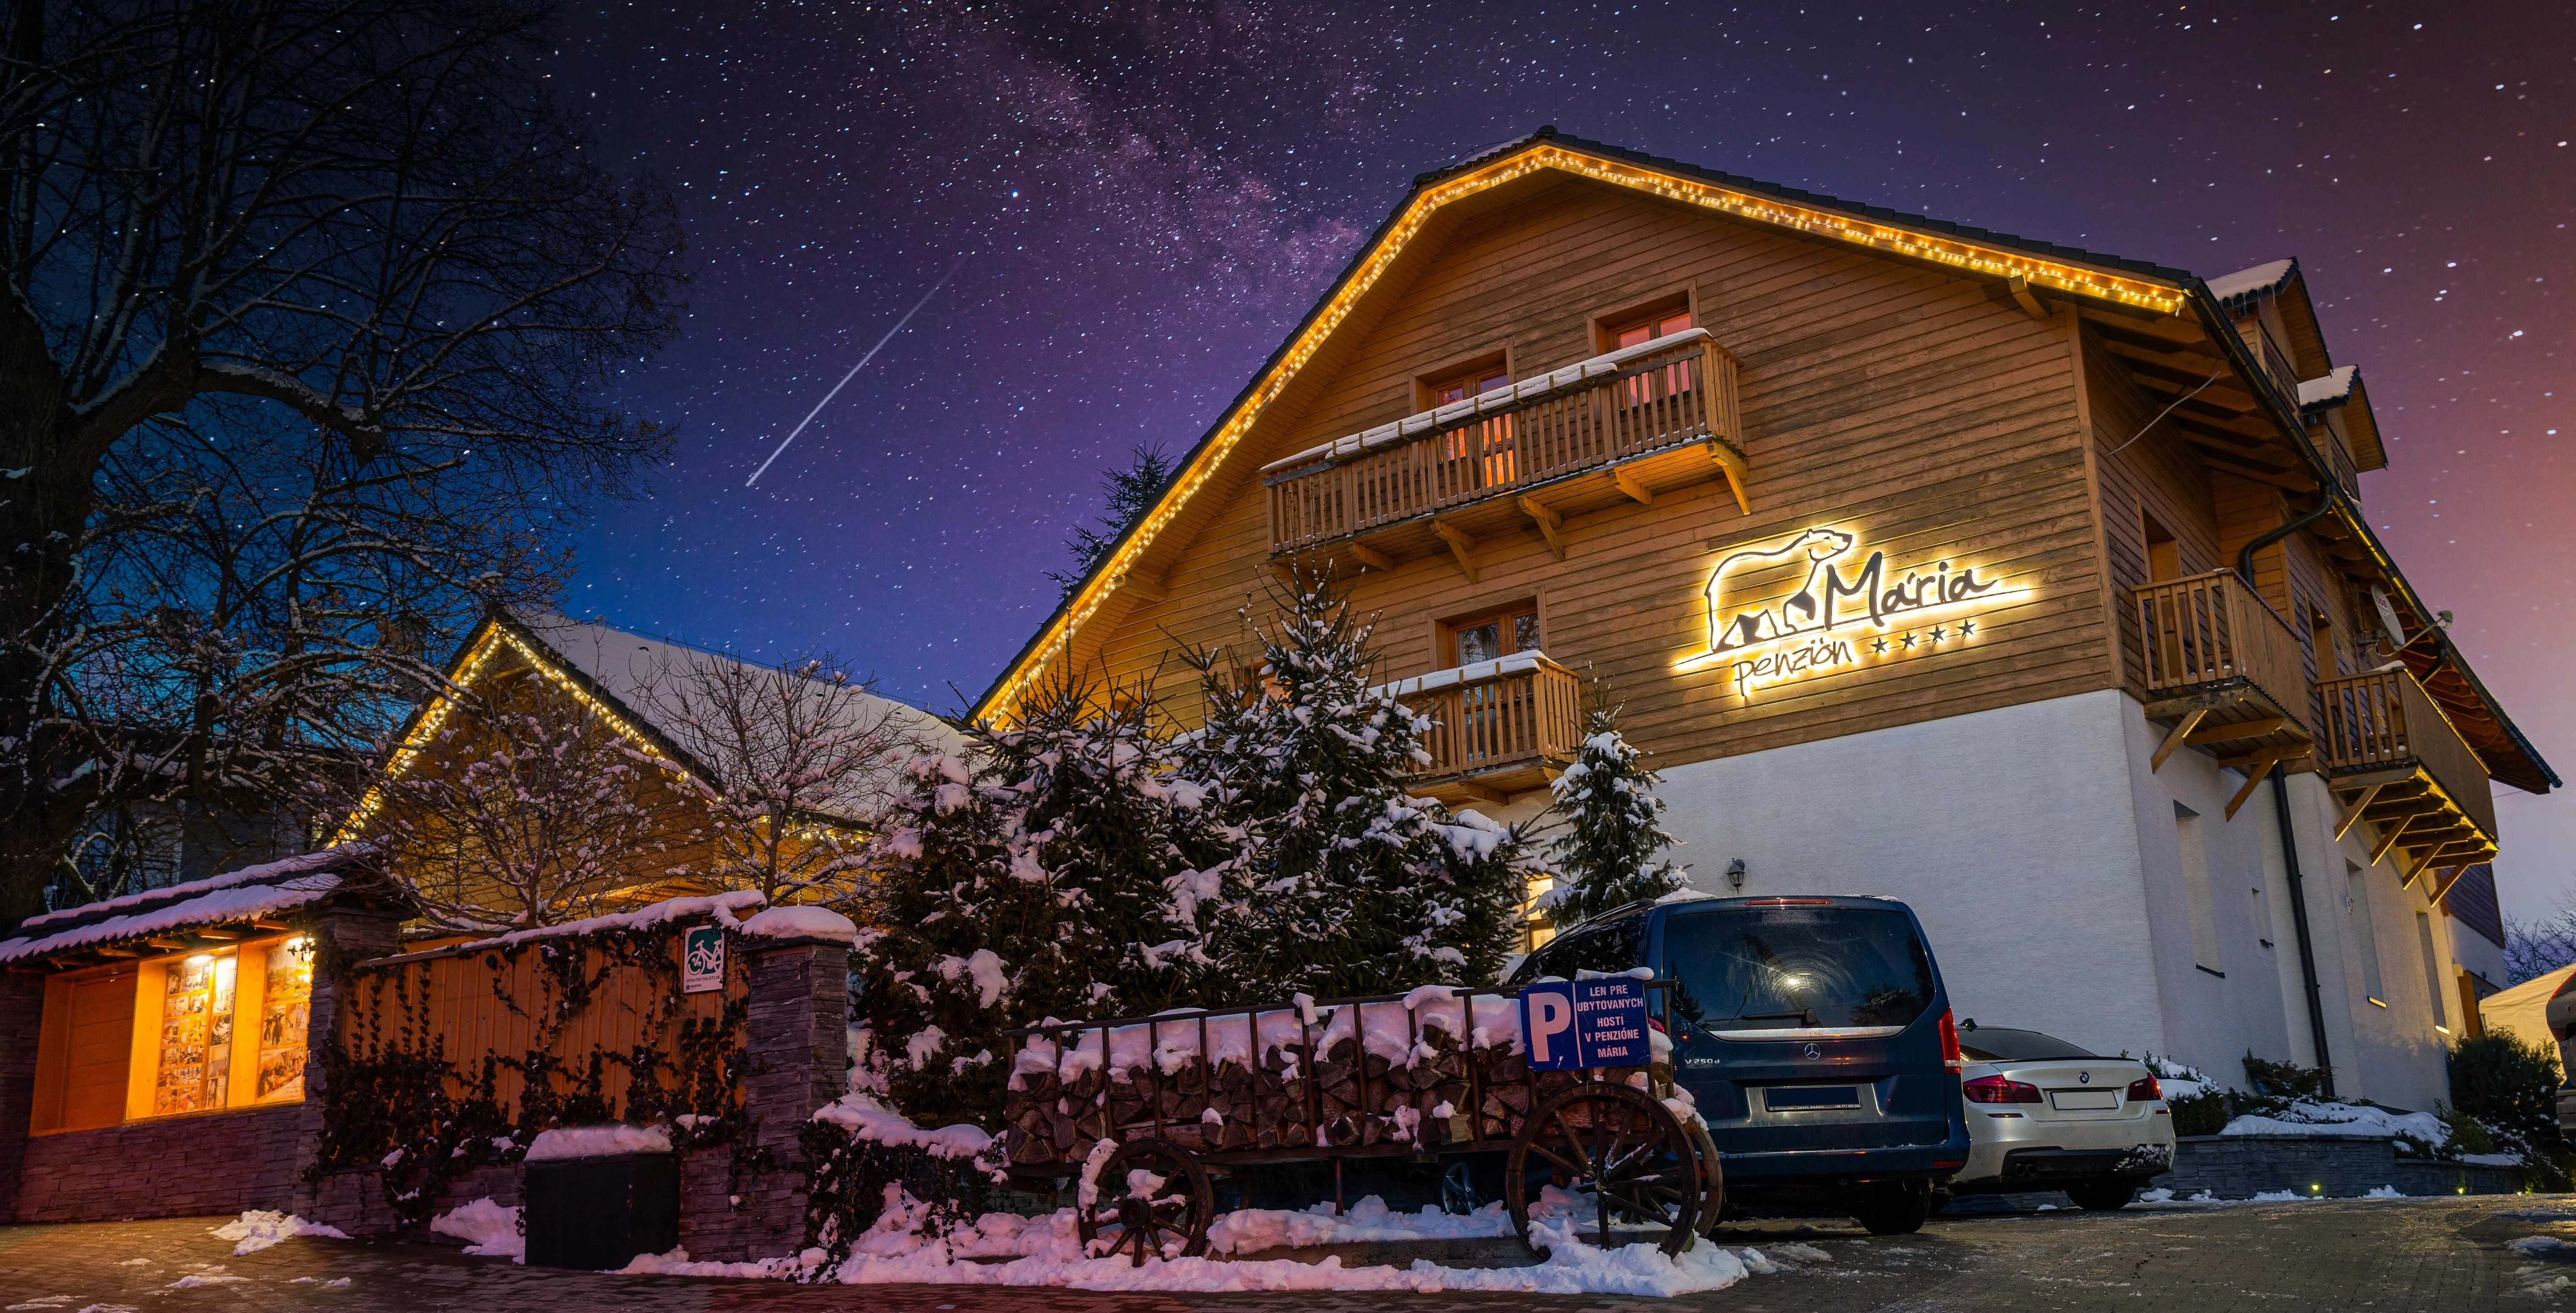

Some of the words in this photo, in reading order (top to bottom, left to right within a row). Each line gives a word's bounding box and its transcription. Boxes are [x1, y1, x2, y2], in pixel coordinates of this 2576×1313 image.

[1825, 551, 1998, 631] Mária
[1590, 986, 1606, 997] LEN
[1610, 985, 1628, 995] PRE
[1577, 997, 1643, 1012] UBYTOVANÝCH
[1528, 992, 1571, 1062] P
[1597, 1014, 1624, 1027] HOSTÍ
[1585, 1033, 1591, 1042] V
[1595, 1028, 1639, 1041] PENZIÓNE
[1597, 1045, 1628, 1058] MÁRIA
